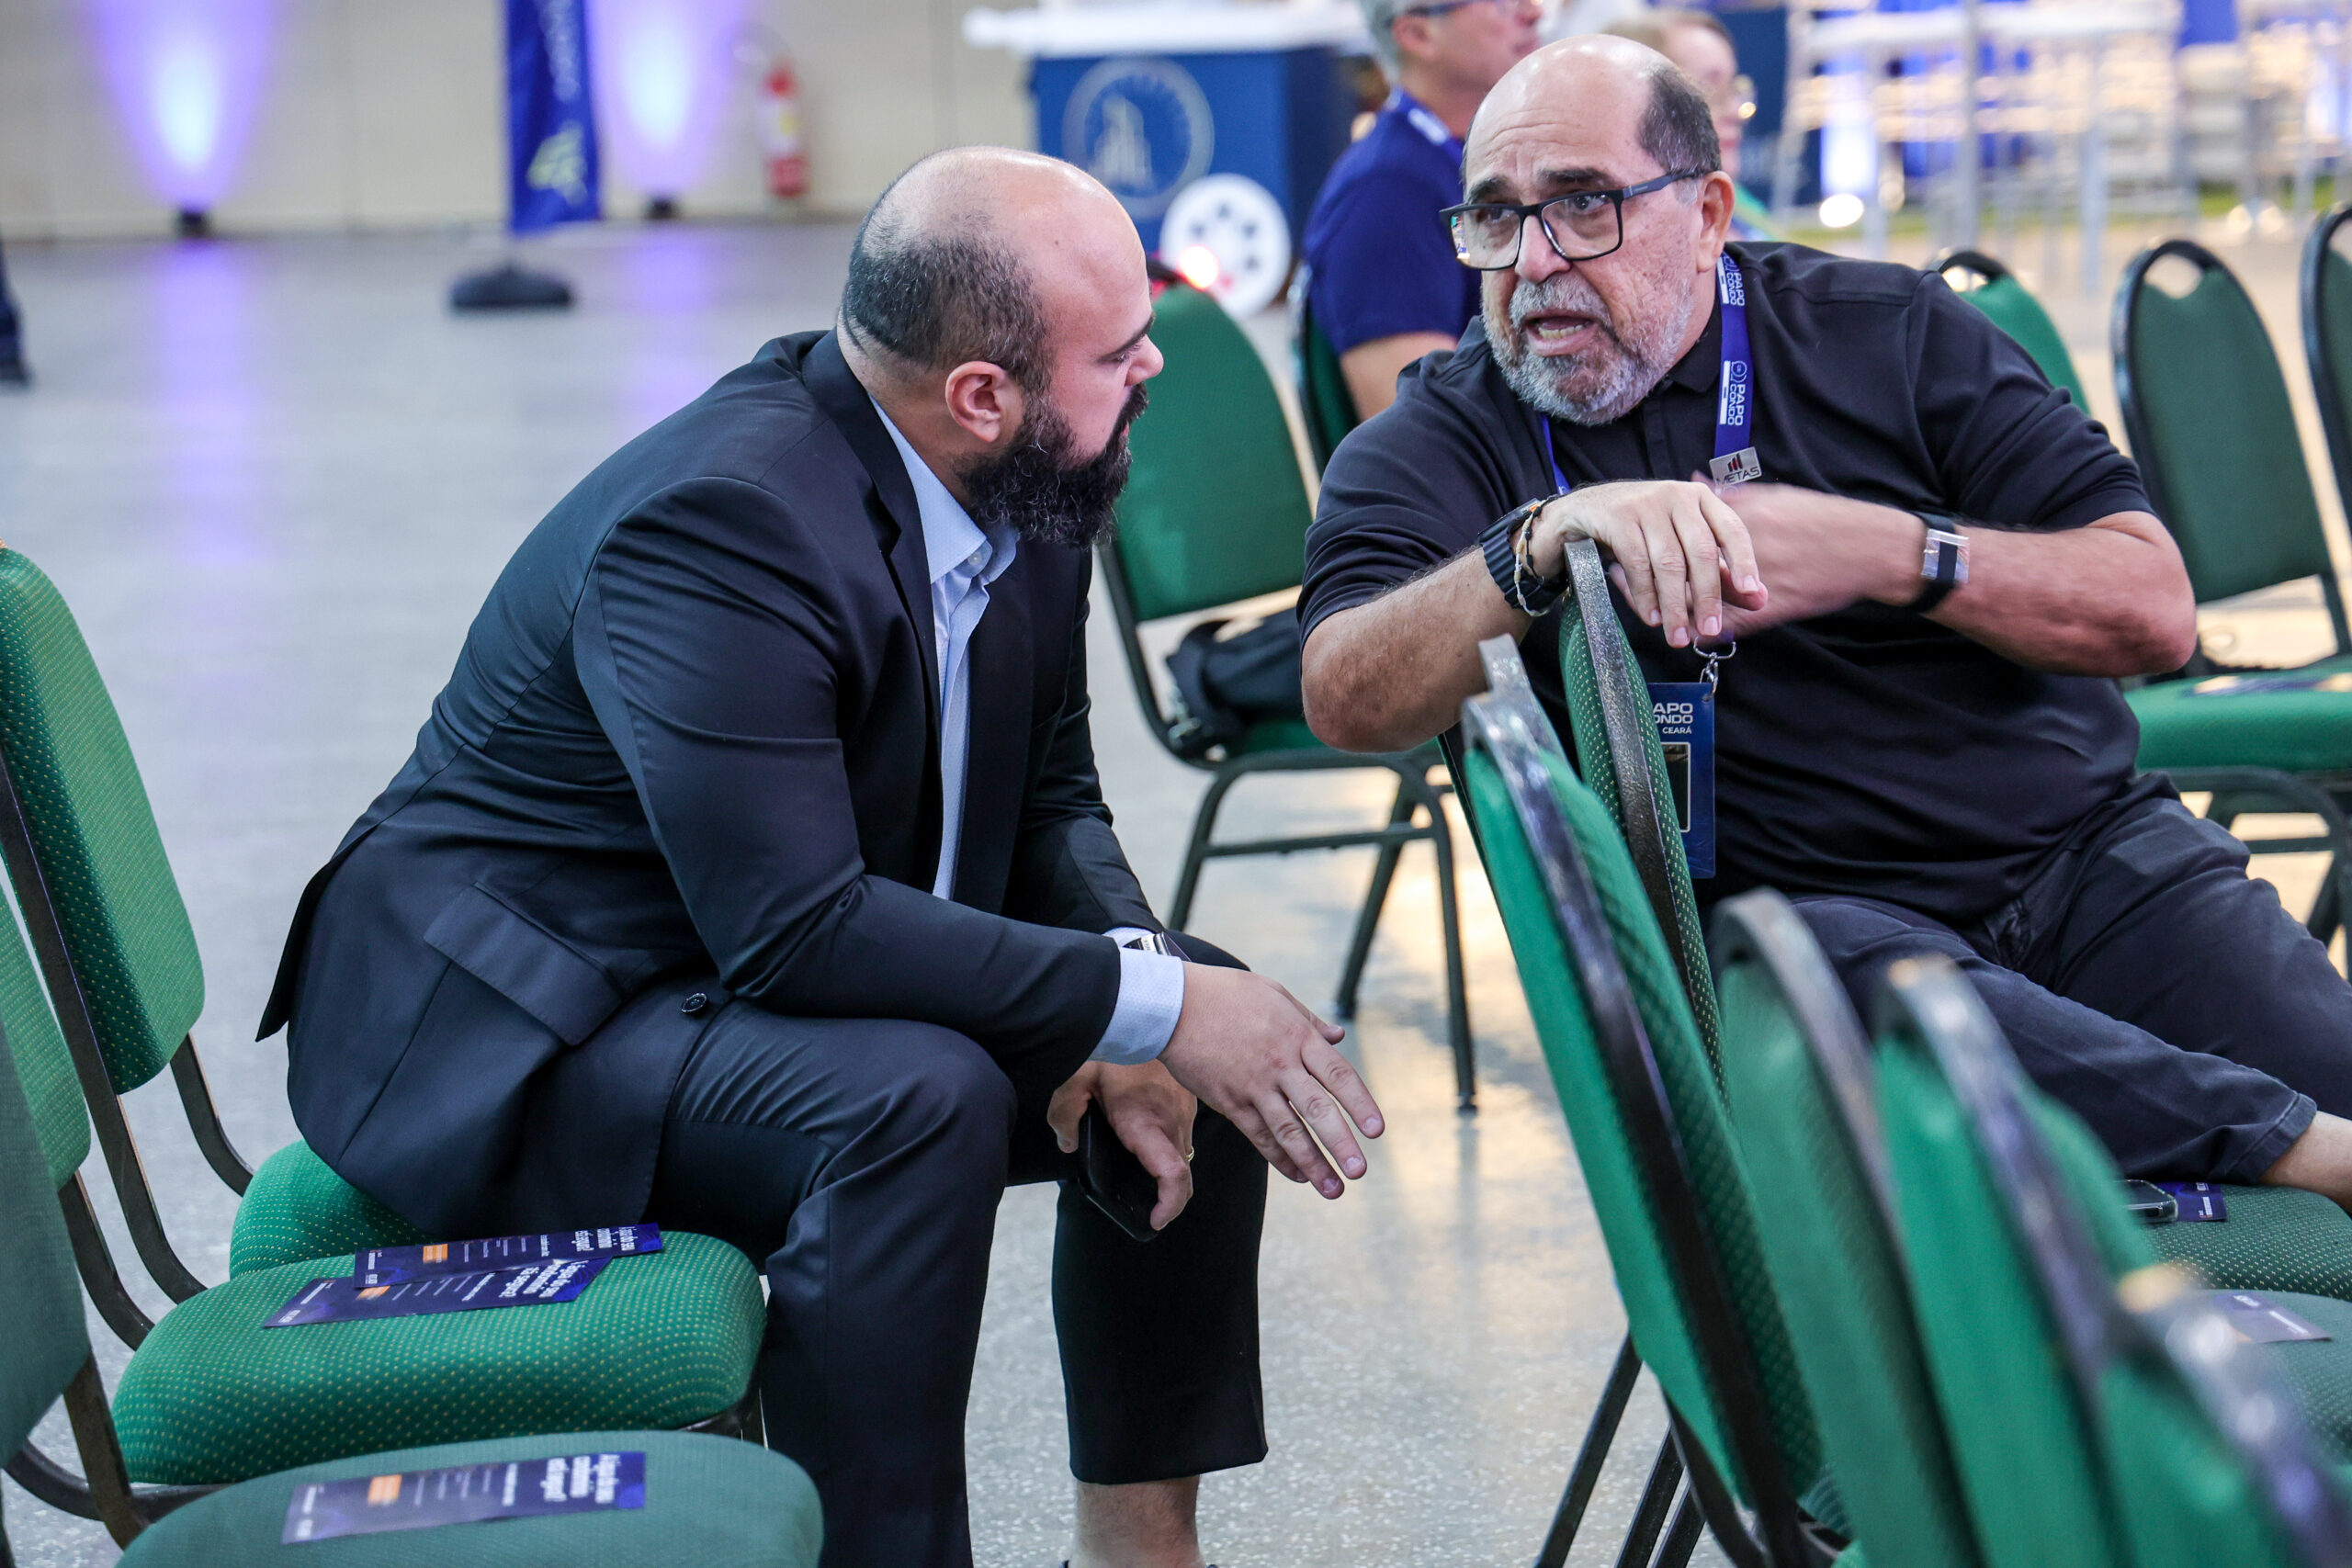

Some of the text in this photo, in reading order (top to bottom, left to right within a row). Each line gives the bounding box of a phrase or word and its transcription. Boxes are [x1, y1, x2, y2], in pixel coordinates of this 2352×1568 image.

[1726, 272, 1737, 306] CONDO
[1734, 272, 1746, 307] PAPO
[1727, 384, 1737, 426] CONDO
[1735, 384, 1746, 426] PAPO
[1653, 702, 1693, 715] APO
[1662, 725, 1692, 735] CEARÁ
